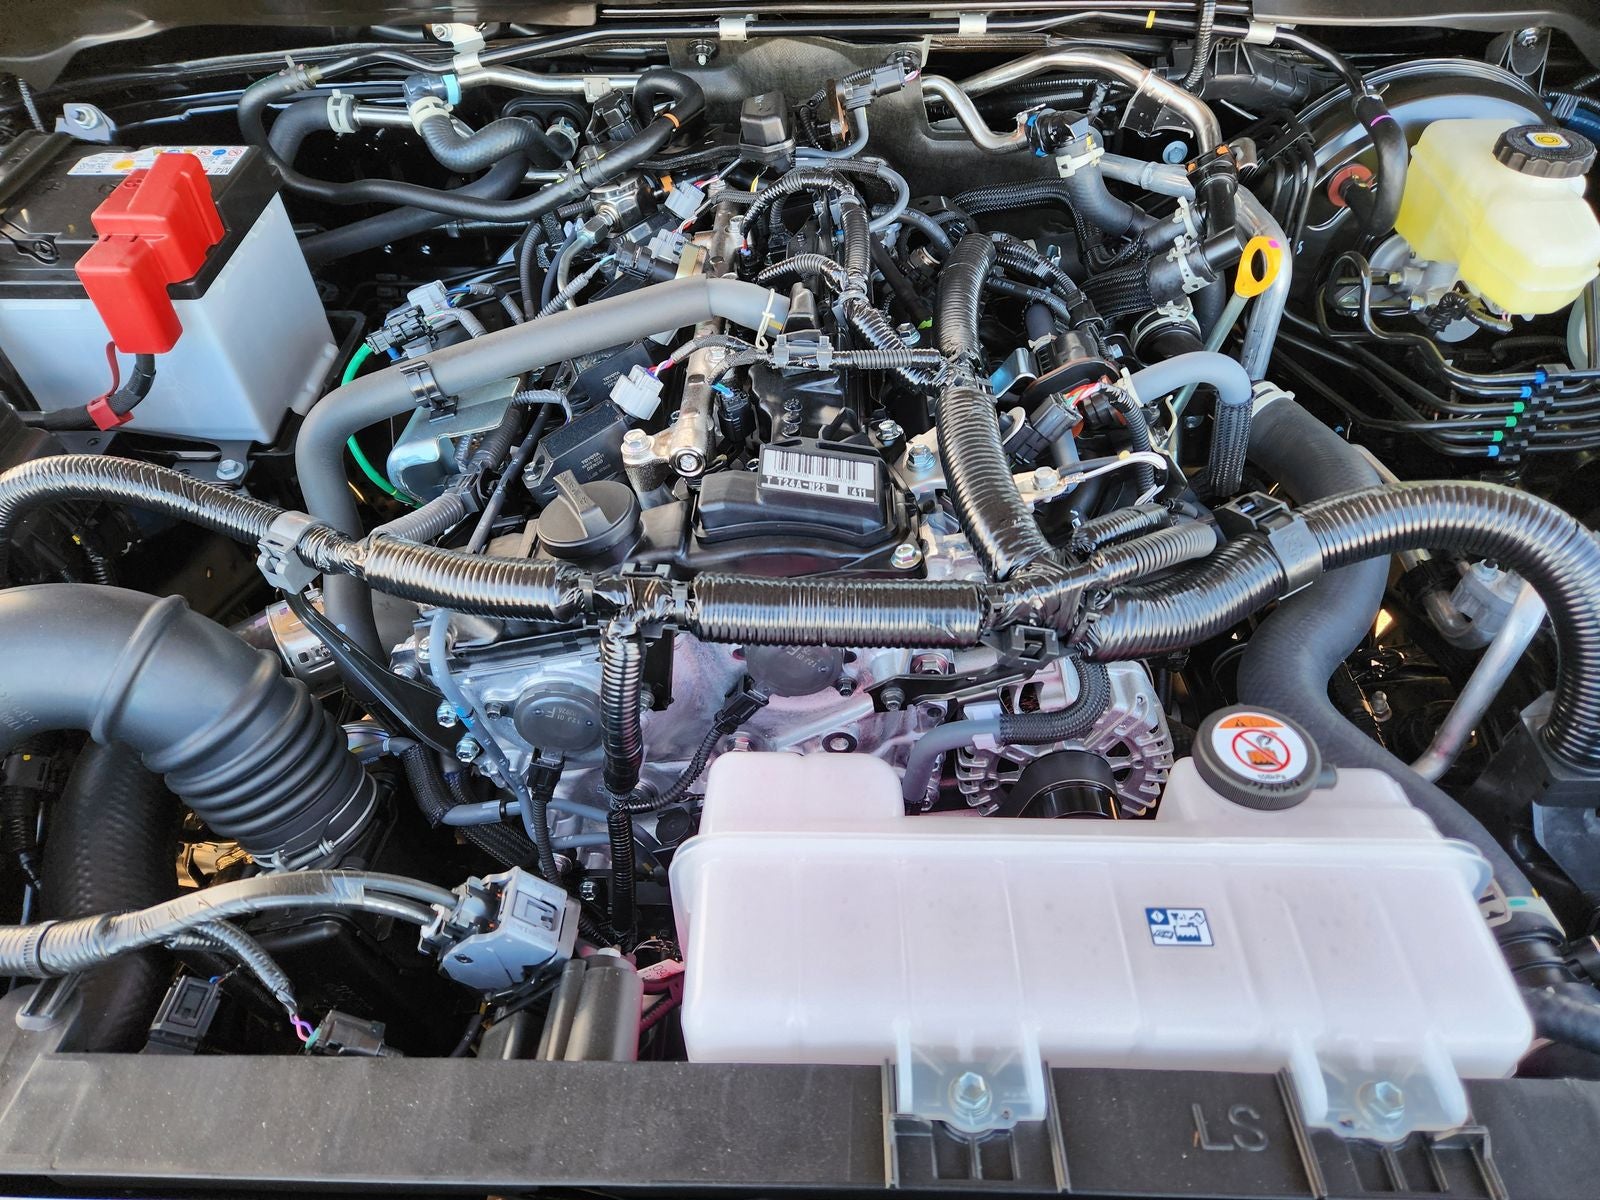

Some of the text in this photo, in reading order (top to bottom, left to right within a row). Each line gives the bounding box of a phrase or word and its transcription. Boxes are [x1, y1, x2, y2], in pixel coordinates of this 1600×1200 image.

[603, 371, 620, 381] TOYOTA
[581, 452, 600, 465] TOYOTA
[1191, 1103, 1269, 1152] LS
